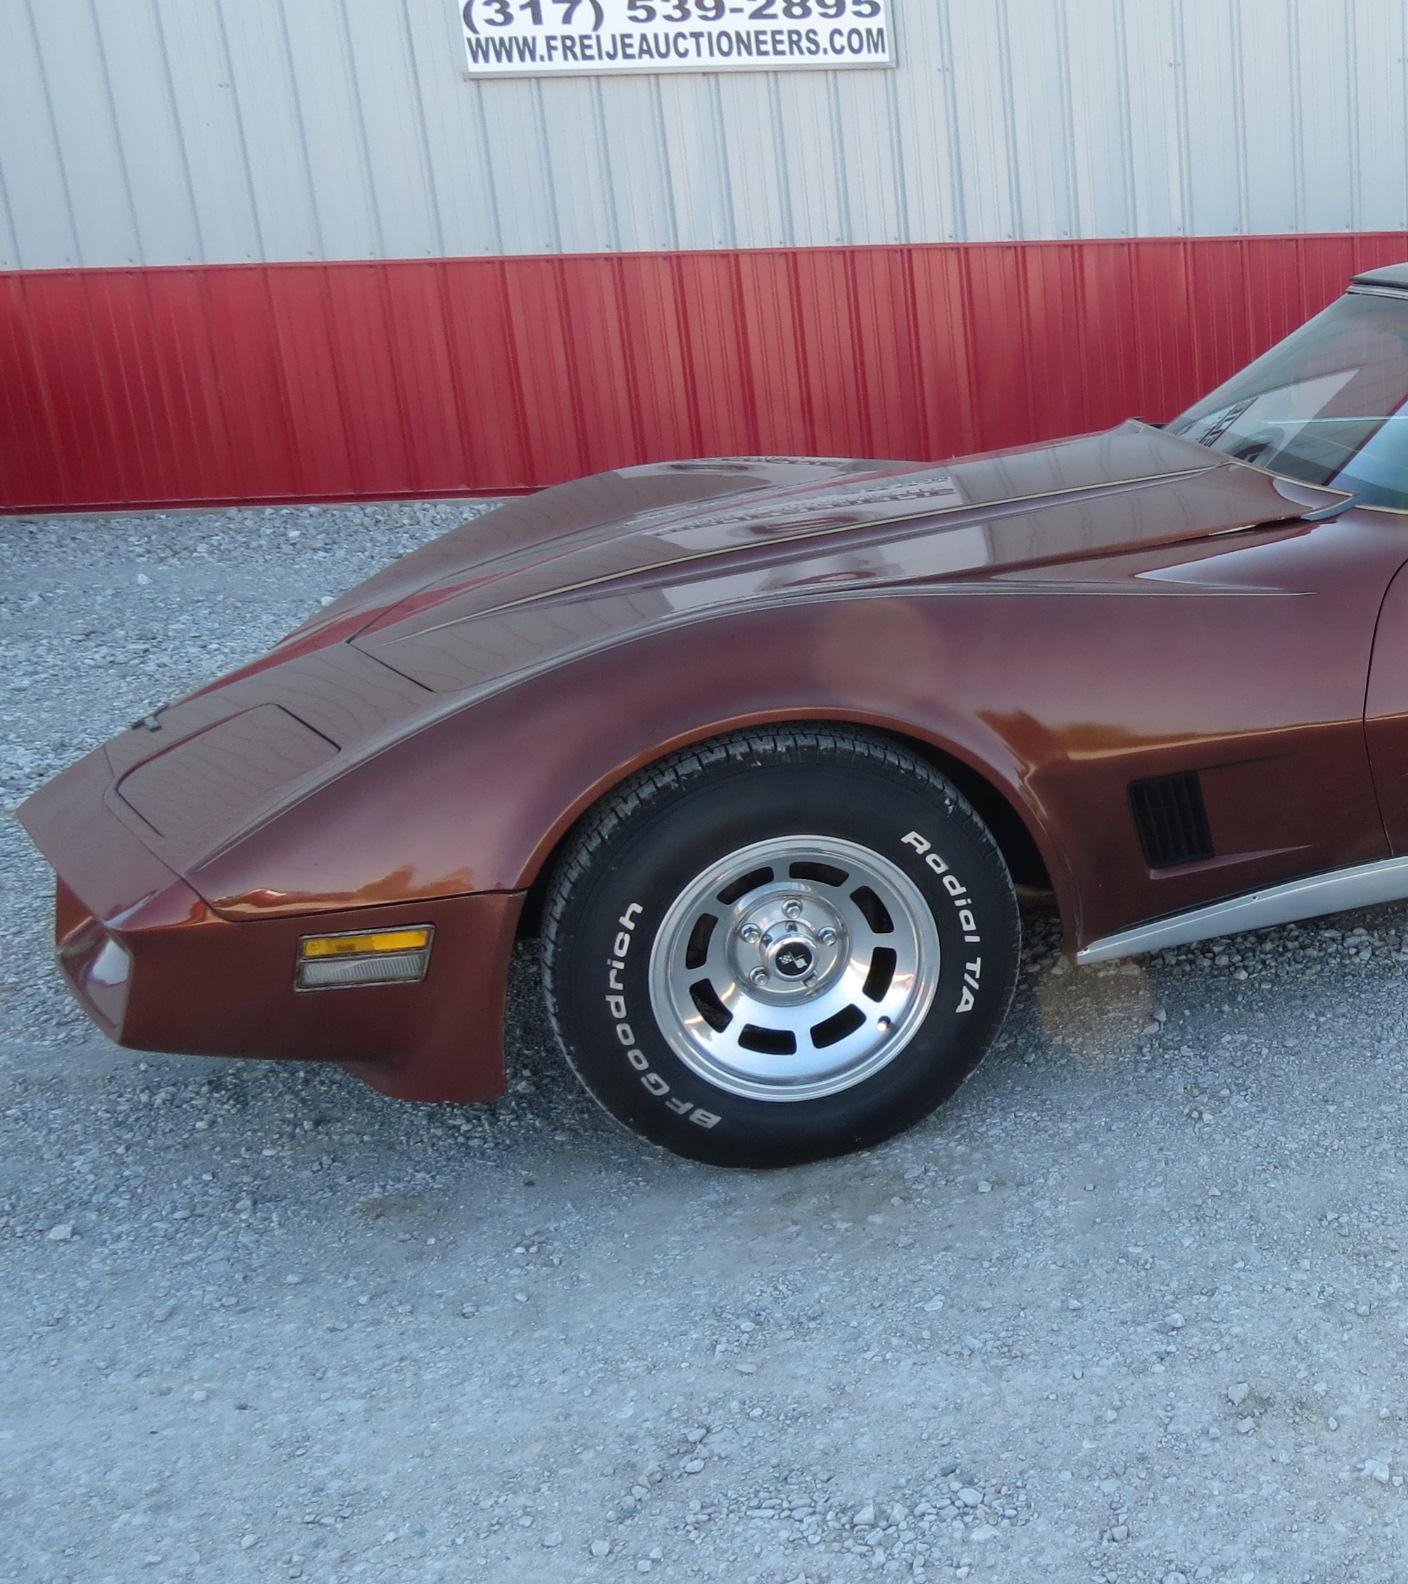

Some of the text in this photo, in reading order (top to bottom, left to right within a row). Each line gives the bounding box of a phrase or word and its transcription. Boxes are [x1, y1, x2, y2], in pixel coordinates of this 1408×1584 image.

[462, 0, 881, 35] (317) 539-2895
[466, 27, 887, 64] WWW.FREIJEAUCTIONEERS.COM
[900, 830, 983, 1014] Radial T/A
[605, 902, 722, 1129] BFGoodrich
